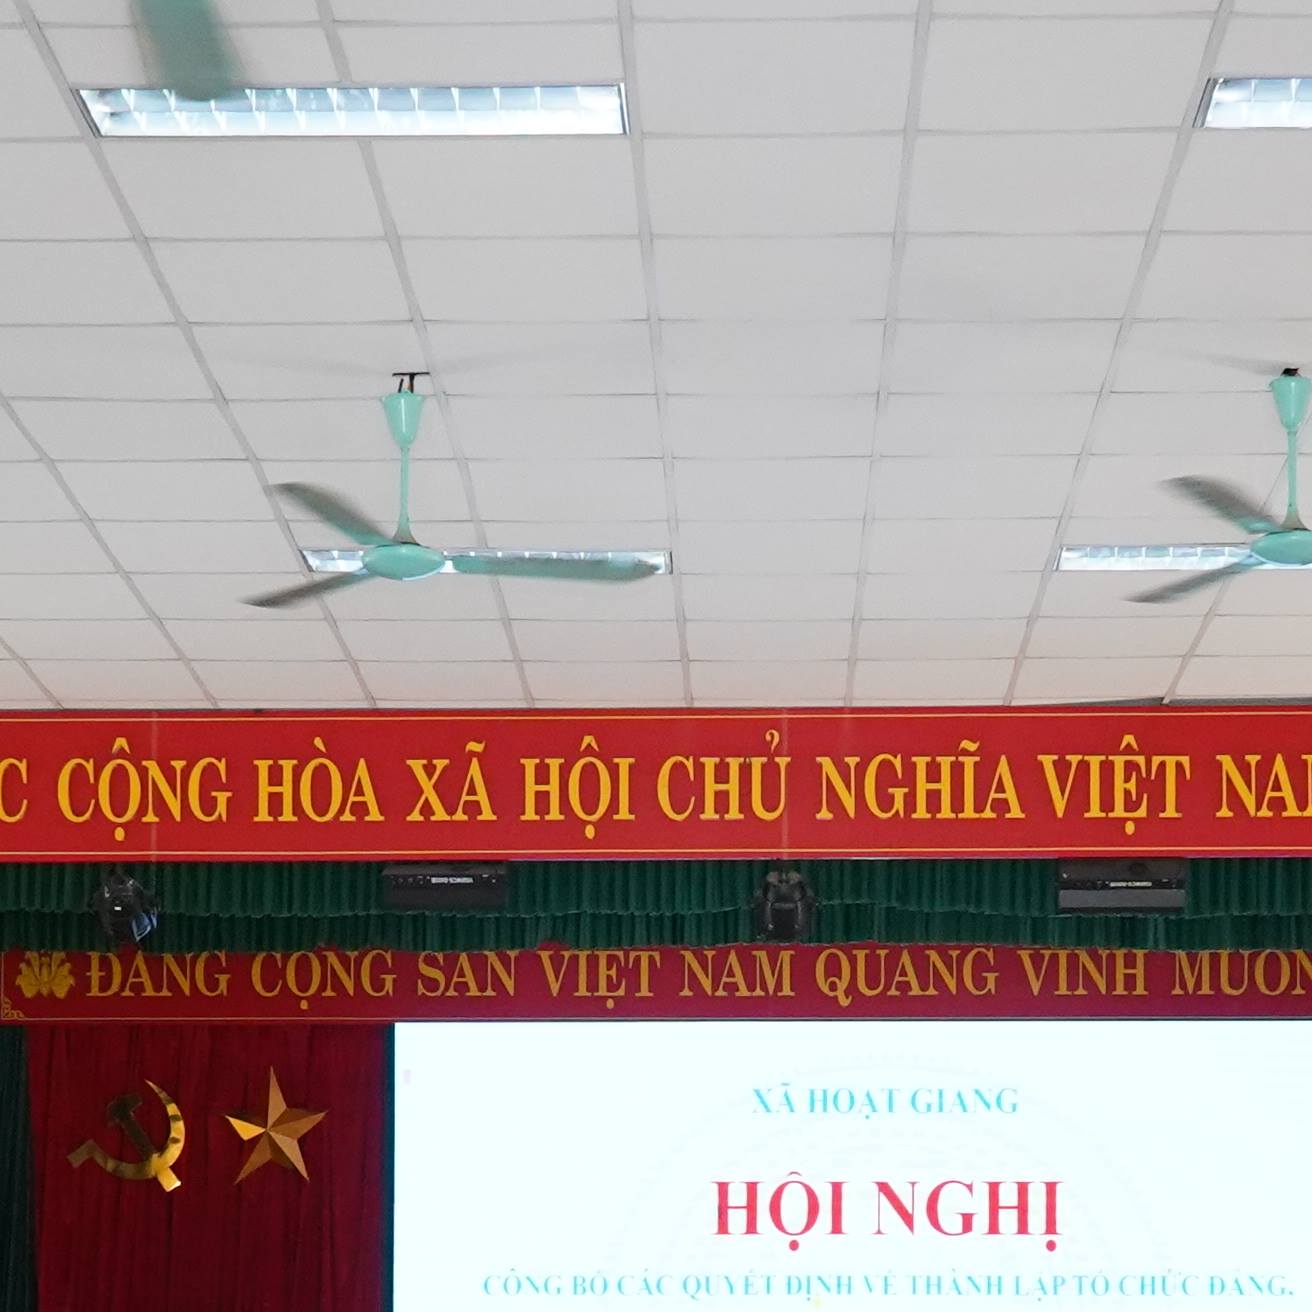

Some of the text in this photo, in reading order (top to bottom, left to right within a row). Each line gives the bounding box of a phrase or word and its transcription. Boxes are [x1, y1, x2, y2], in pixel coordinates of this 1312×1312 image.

[57, 736, 233, 841] CỘNG
[252, 736, 384, 823] HÒA
[406, 740, 498, 822] XÃ
[520, 735, 634, 839] HỘI
[657, 729, 791, 821] CHỦ
[816, 740, 1025, 820] NGHĨA
[1037, 734, 1190, 835] VIỆT
[679, 951, 795, 996] NAM
[814, 948, 998, 1006] QUANG
[1017, 948, 1148, 996] VINH
[752, 1082, 1019, 1120] XÃ HOẠT GIANG
[711, 1171, 1064, 1252] HỘI NGHỊ
